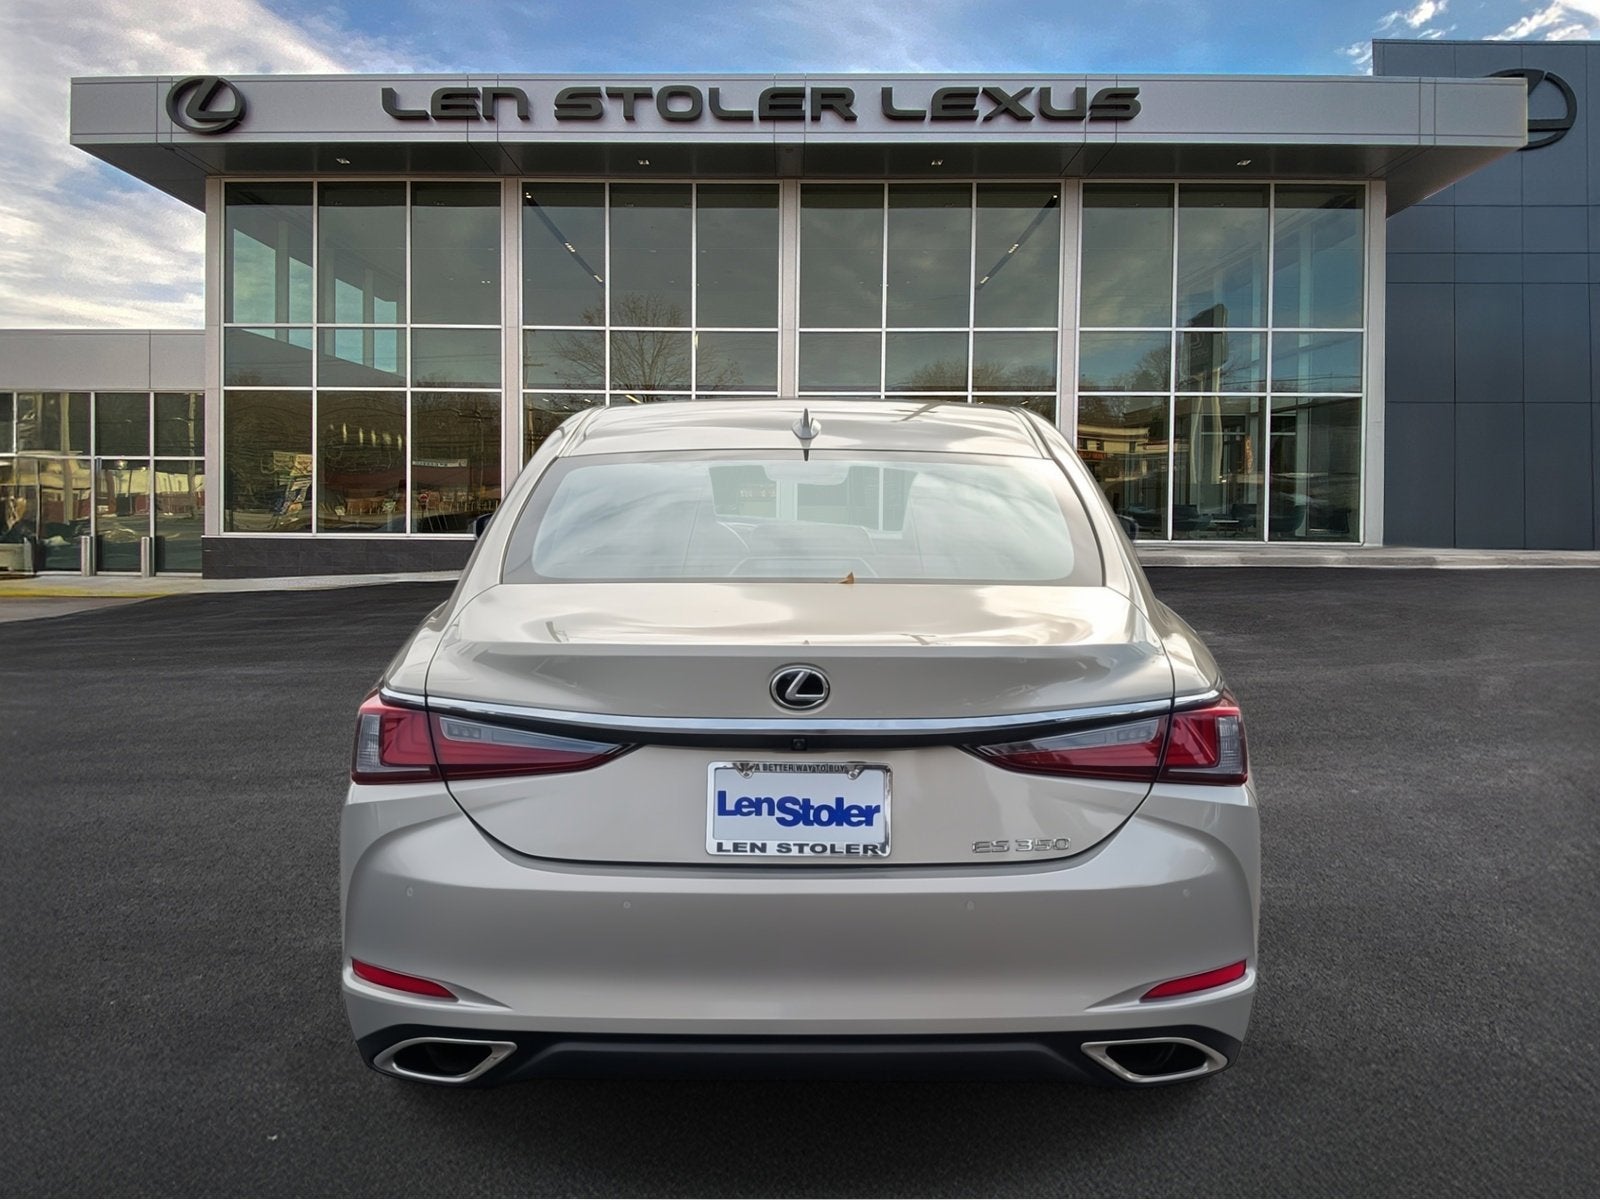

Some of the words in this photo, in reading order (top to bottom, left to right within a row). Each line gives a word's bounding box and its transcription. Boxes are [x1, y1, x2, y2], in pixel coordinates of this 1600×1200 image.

[381, 86, 531, 121] LEN
[554, 86, 857, 121] STOLER
[882, 86, 1141, 121] LEXUS
[763, 763, 793, 773] BETTER
[796, 763, 812, 773] WAY
[829, 763, 844, 773] BUY
[716, 842, 767, 854] LEN
[776, 842, 880, 855] STOLER
[972, 840, 1010, 853] ES
[1015, 838, 1071, 852] 350
